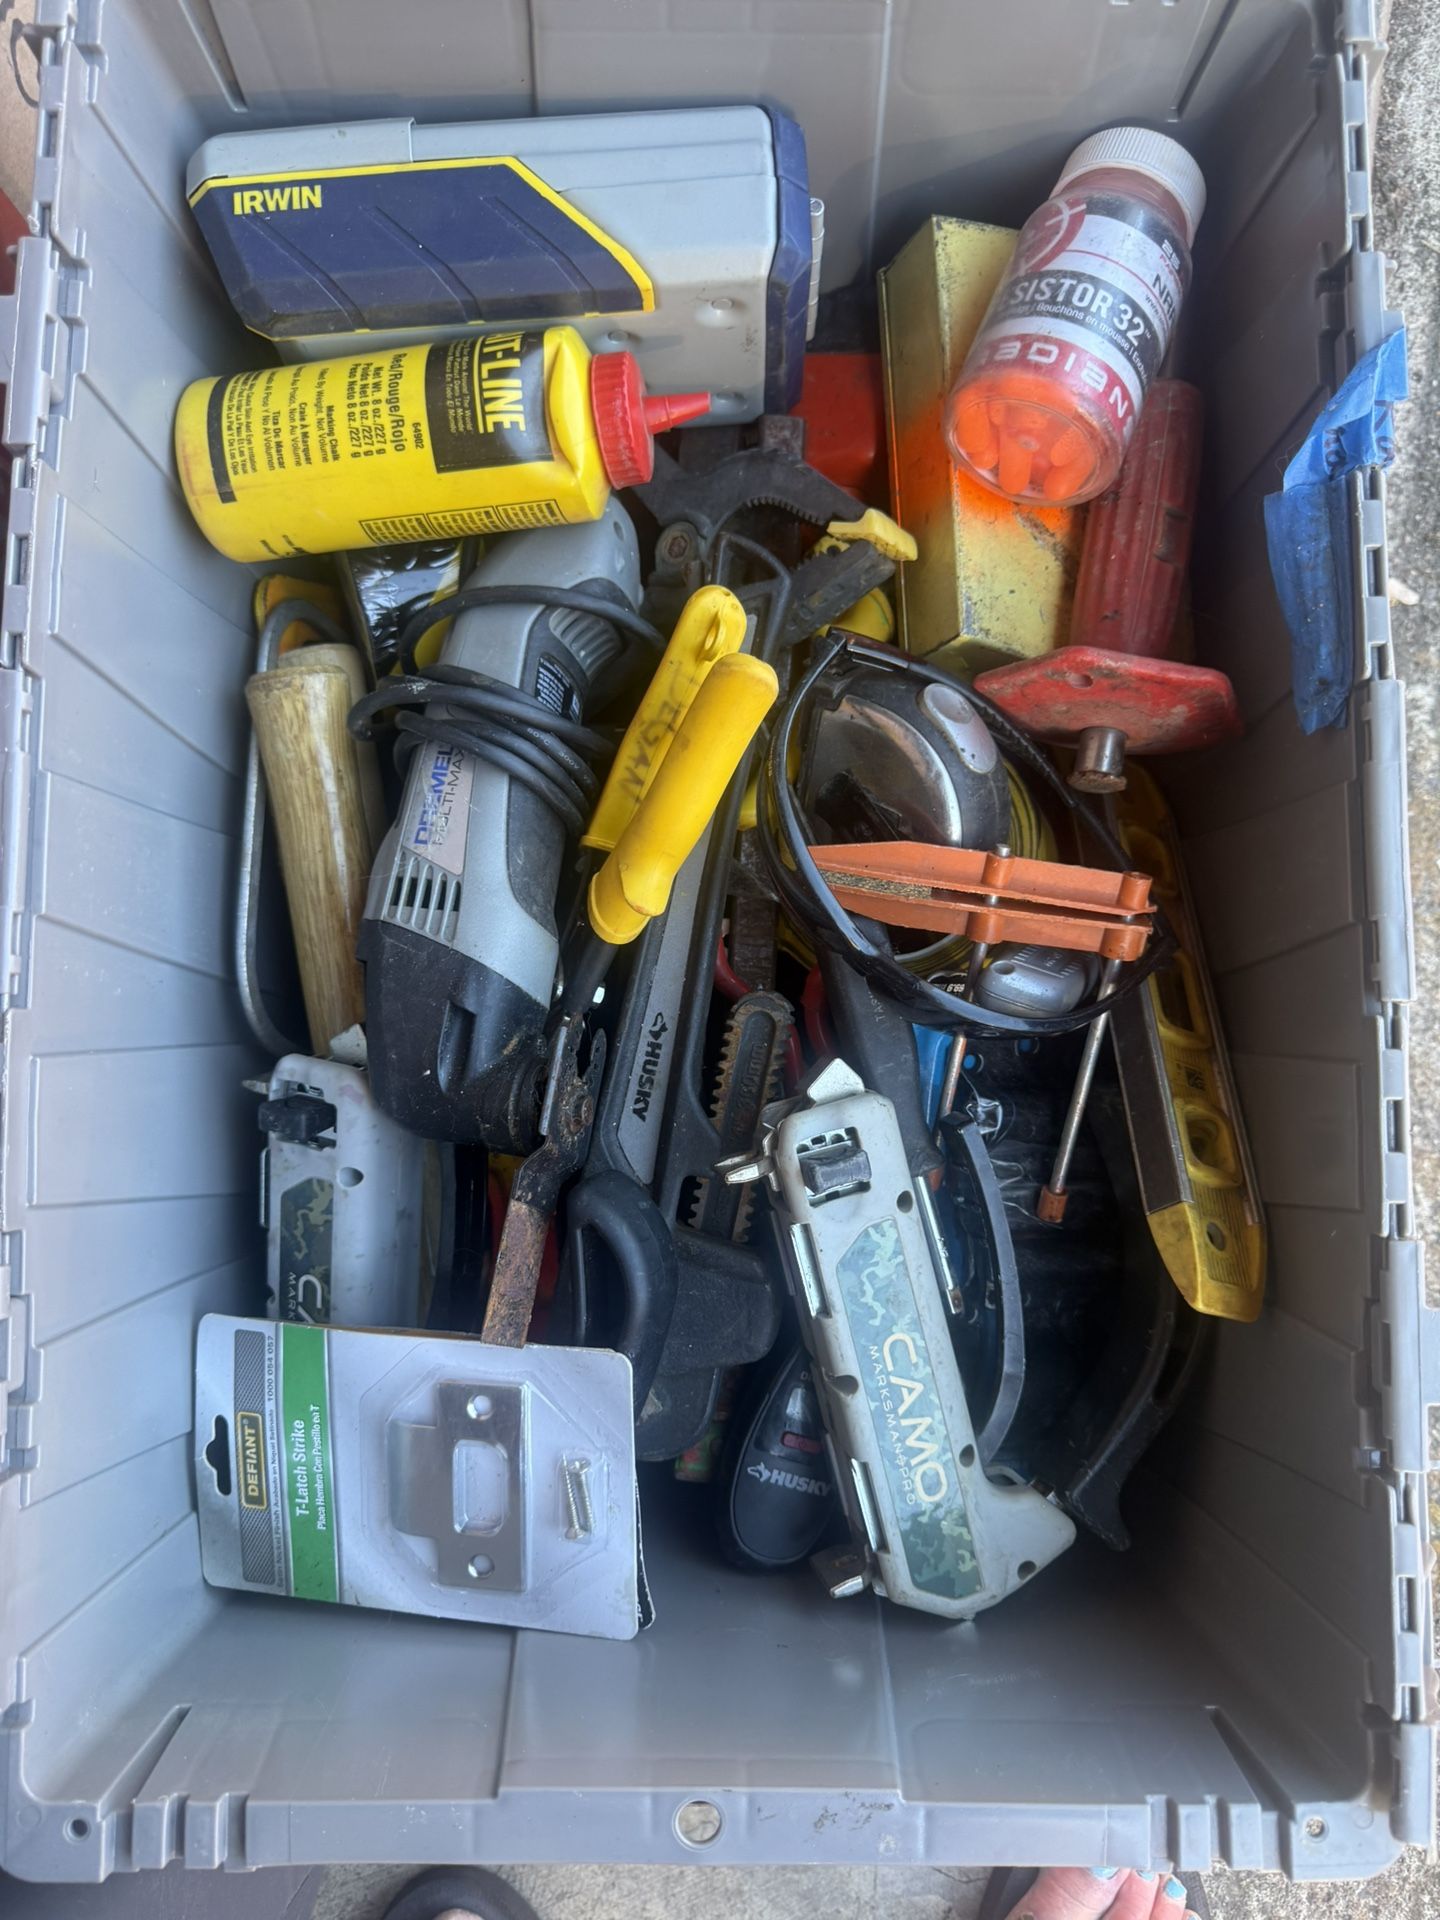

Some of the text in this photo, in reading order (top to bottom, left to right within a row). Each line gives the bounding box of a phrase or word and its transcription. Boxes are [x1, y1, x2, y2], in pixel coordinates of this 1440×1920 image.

[233, 184, 322, 215] IRWIN
[1161, 239, 1181, 270] 25
[1037, 302, 1085, 321] Bouchons
[1086, 315, 1099, 327] en
[1099, 322, 1131, 352] mousse
[1112, 303, 1145, 346] 32
[315, 380, 326, 389] By
[348, 363, 361, 379] Peso
[360, 362, 373, 381] Poids
[372, 367, 384, 379] Net
[262, 392, 271, 407] Peso
[347, 380, 357, 400] Neto
[359, 383, 370, 399] Net
[371, 380, 382, 396] Wt.
[289, 408, 297, 423] Non
[299, 402, 308, 422] Craie
[386, 353, 408, 452] Red/Rouge/Rojo
[262, 415, 270, 426] No
[262, 427, 271, 435] Al
[290, 425, 298, 435] Au
[316, 417, 326, 431] Not
[325, 405, 341, 461] Marking Chalk
[347, 411, 361, 448] oz./227
[360, 410, 374, 446] oz./227
[372, 408, 387, 444] oz./227
[246, 434, 254, 445] Eye
[272, 411, 286, 469] Tiza De Marcar
[301, 431, 312, 465] Marquer
[318, 433, 330, 463] Volume
[412, 422, 424, 449] 64902
[248, 447, 258, 473] Irritation
[264, 435, 276, 471] Volumen
[291, 437, 302, 467] Volume
[632, 1041, 662, 1122] HUSKY
[310, 1404, 320, 1412] T
[883, 1332, 948, 1503] CAMO
[869, 1345, 916, 1505] MARKSMAN PRO
[311, 1424, 322, 1455] Pestillo
[244, 1425, 259, 1496] DEFIANT
[272, 1466, 278, 1475] en
[291, 1420, 310, 1517] T-Latch Strike
[313, 1456, 324, 1473] Con
[314, 1473, 325, 1505] Hembra
[769, 1469, 830, 1497] HUSKY
[273, 1510, 281, 1534] Finish
[316, 1506, 327, 1530] Placa
